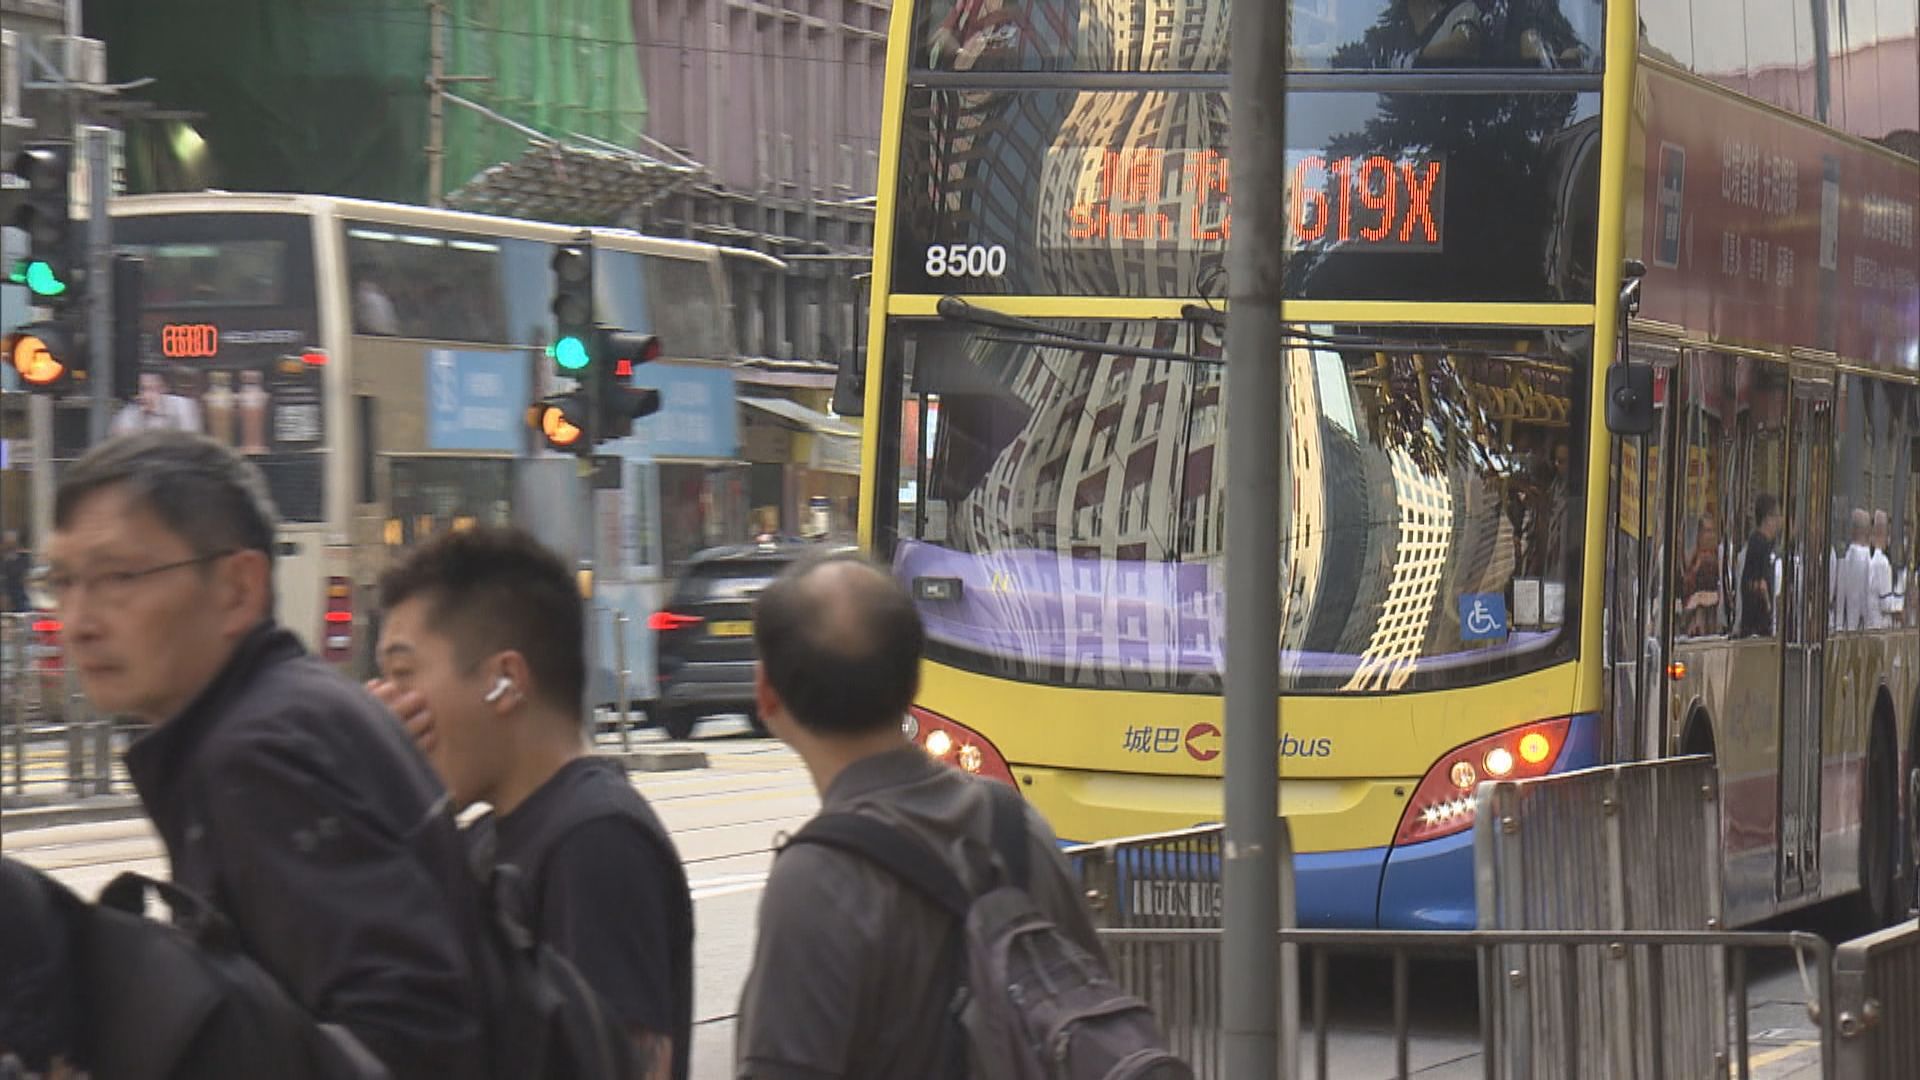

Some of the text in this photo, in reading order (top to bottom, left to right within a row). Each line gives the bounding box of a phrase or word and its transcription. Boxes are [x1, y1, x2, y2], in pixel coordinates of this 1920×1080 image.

[1291, 156, 1441, 243] 619X
[1069, 204, 1169, 240] Shun
[925, 244, 1007, 277] 8500
[1122, 725, 1180, 753] 城巴
[1279, 733, 1332, 757] bus
